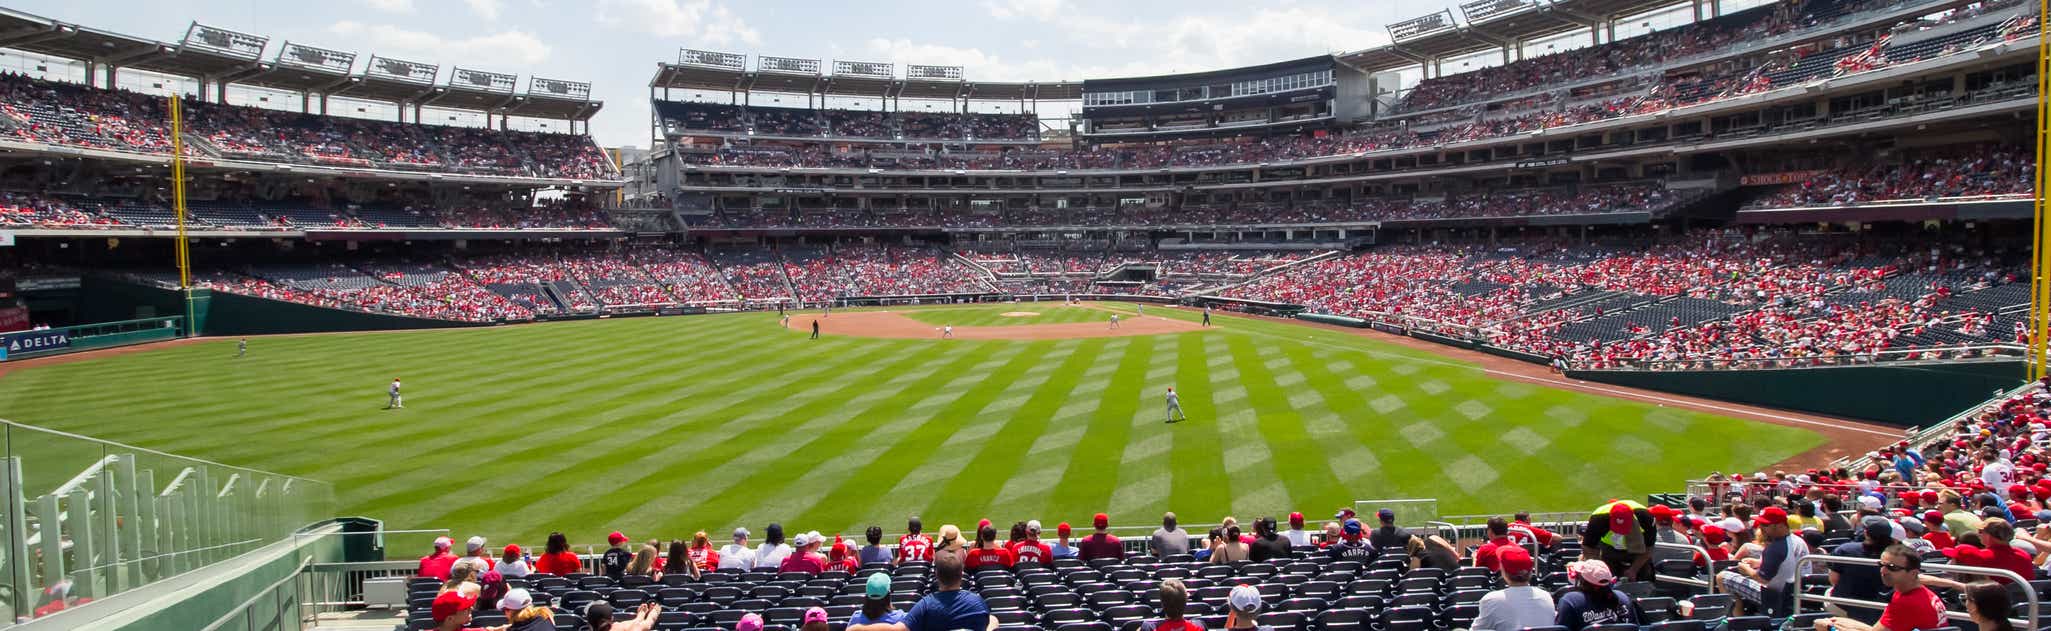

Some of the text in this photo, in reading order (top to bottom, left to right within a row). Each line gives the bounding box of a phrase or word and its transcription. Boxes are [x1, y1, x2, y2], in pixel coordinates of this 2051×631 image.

[24, 336, 67, 347] DELTA
[904, 545, 926, 561] 37
[607, 557, 618, 566] 34
